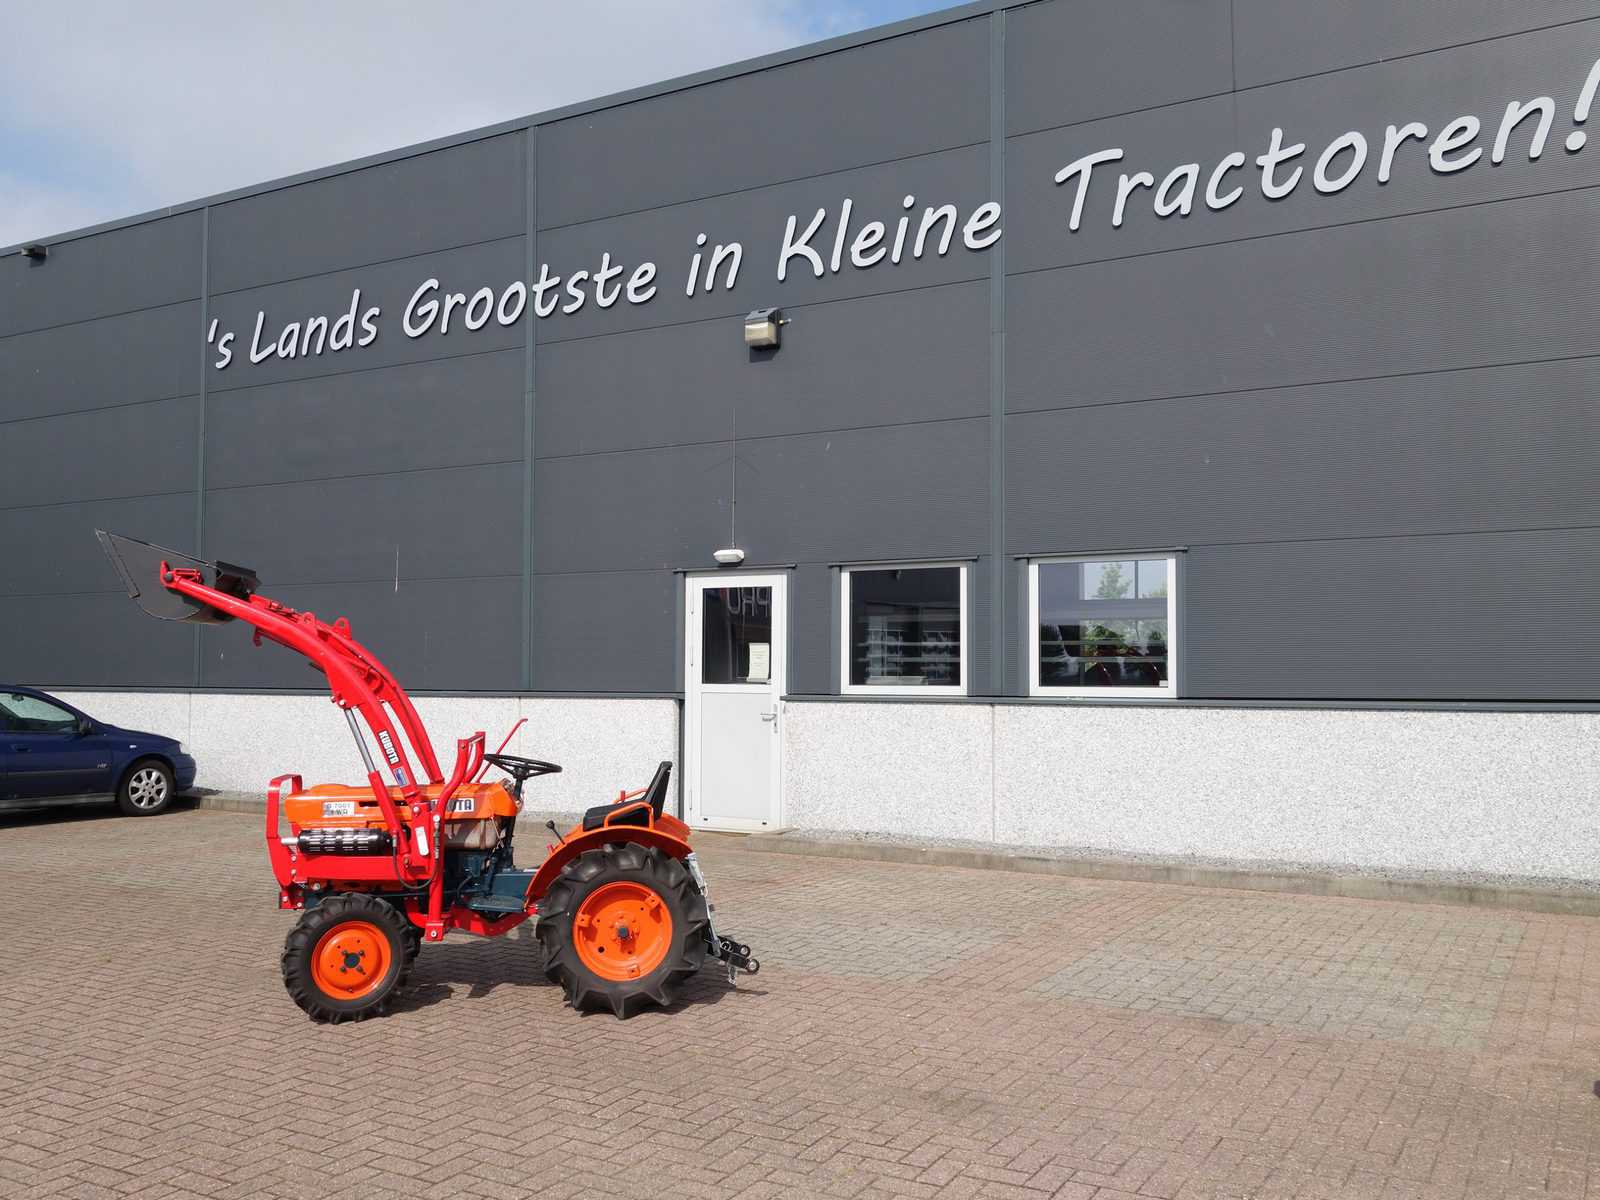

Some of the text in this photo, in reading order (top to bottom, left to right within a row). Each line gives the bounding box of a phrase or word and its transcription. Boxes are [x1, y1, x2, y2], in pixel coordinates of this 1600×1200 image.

[207, 58, 1600, 369] 's Lands Grootste in Kleine Tractoren!
[378, 730, 400, 764] KUBOTA
